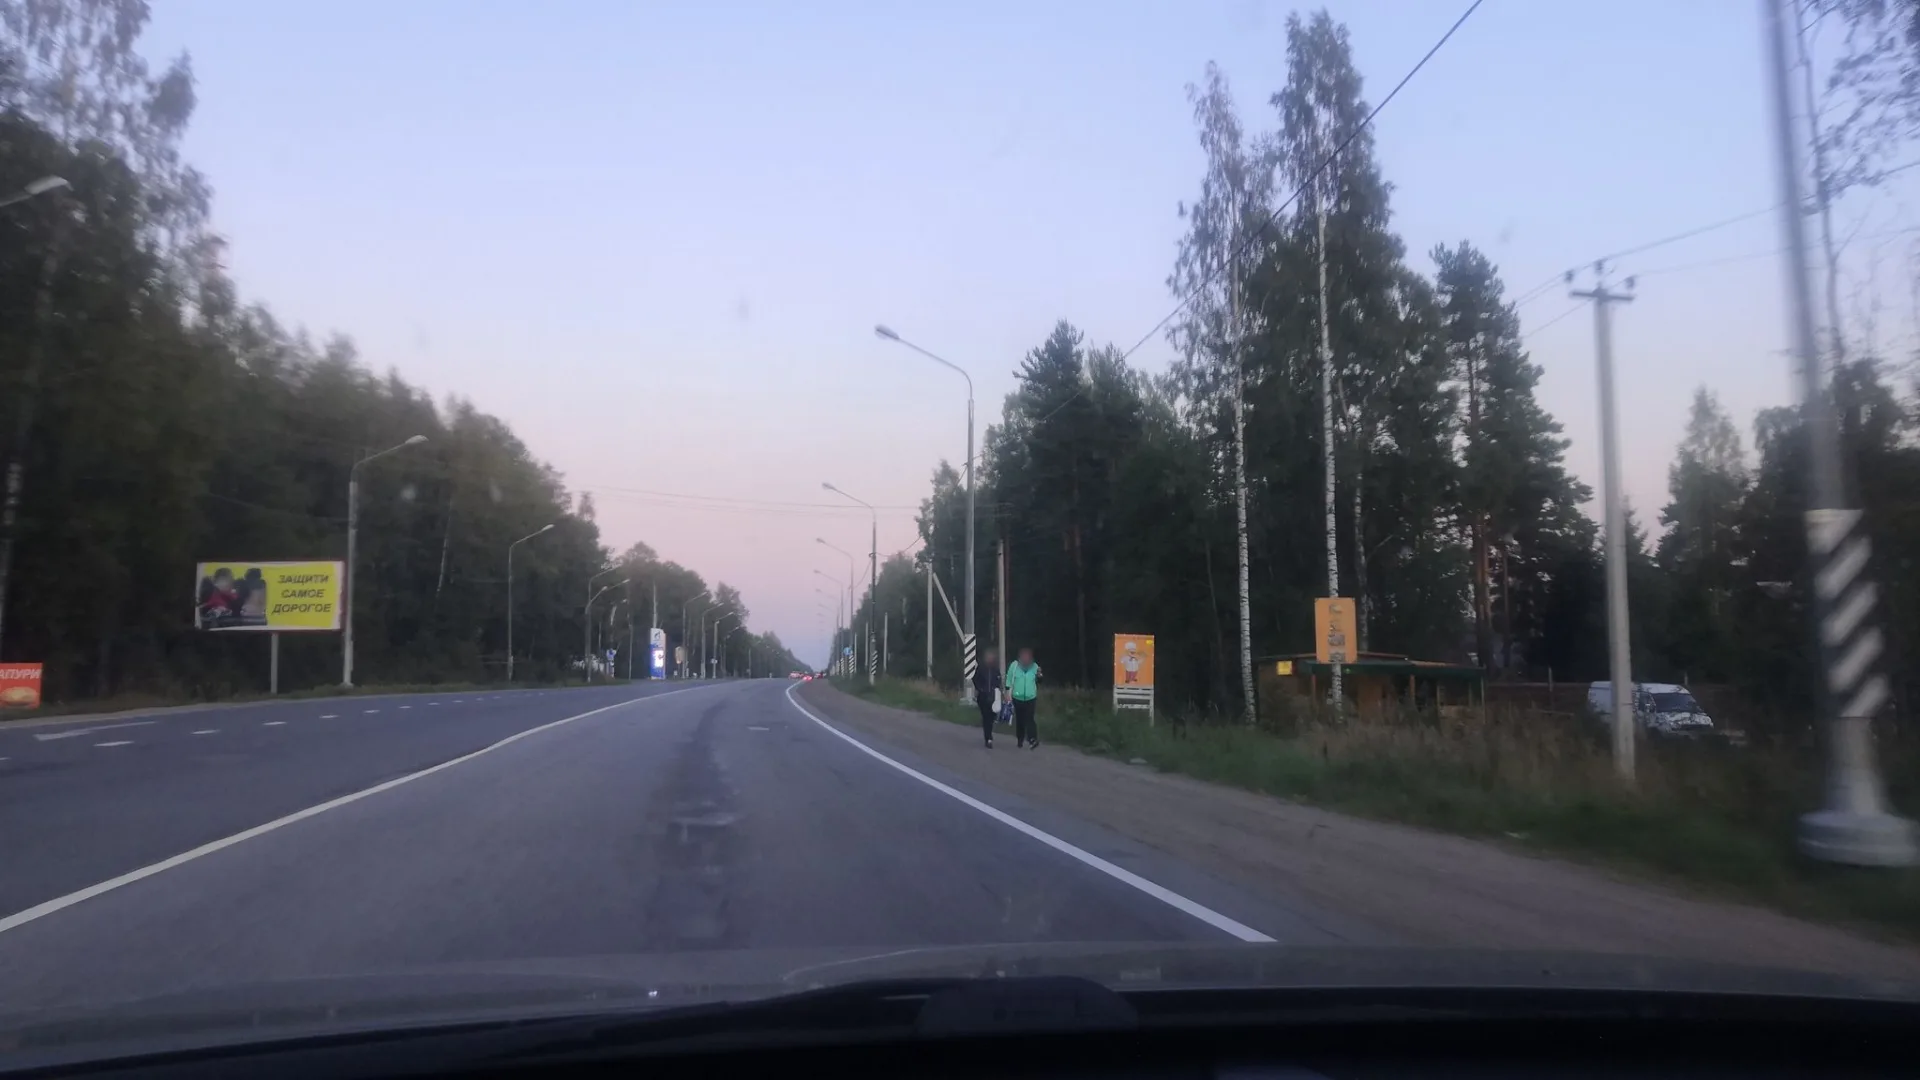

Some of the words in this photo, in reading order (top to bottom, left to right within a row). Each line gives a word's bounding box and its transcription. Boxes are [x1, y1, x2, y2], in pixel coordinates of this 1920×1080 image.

[278, 574, 329, 585] ЗАЩИТИ
[281, 588, 325, 598] САМОЕ
[272, 603, 332, 614] ДОРОГОЕ
